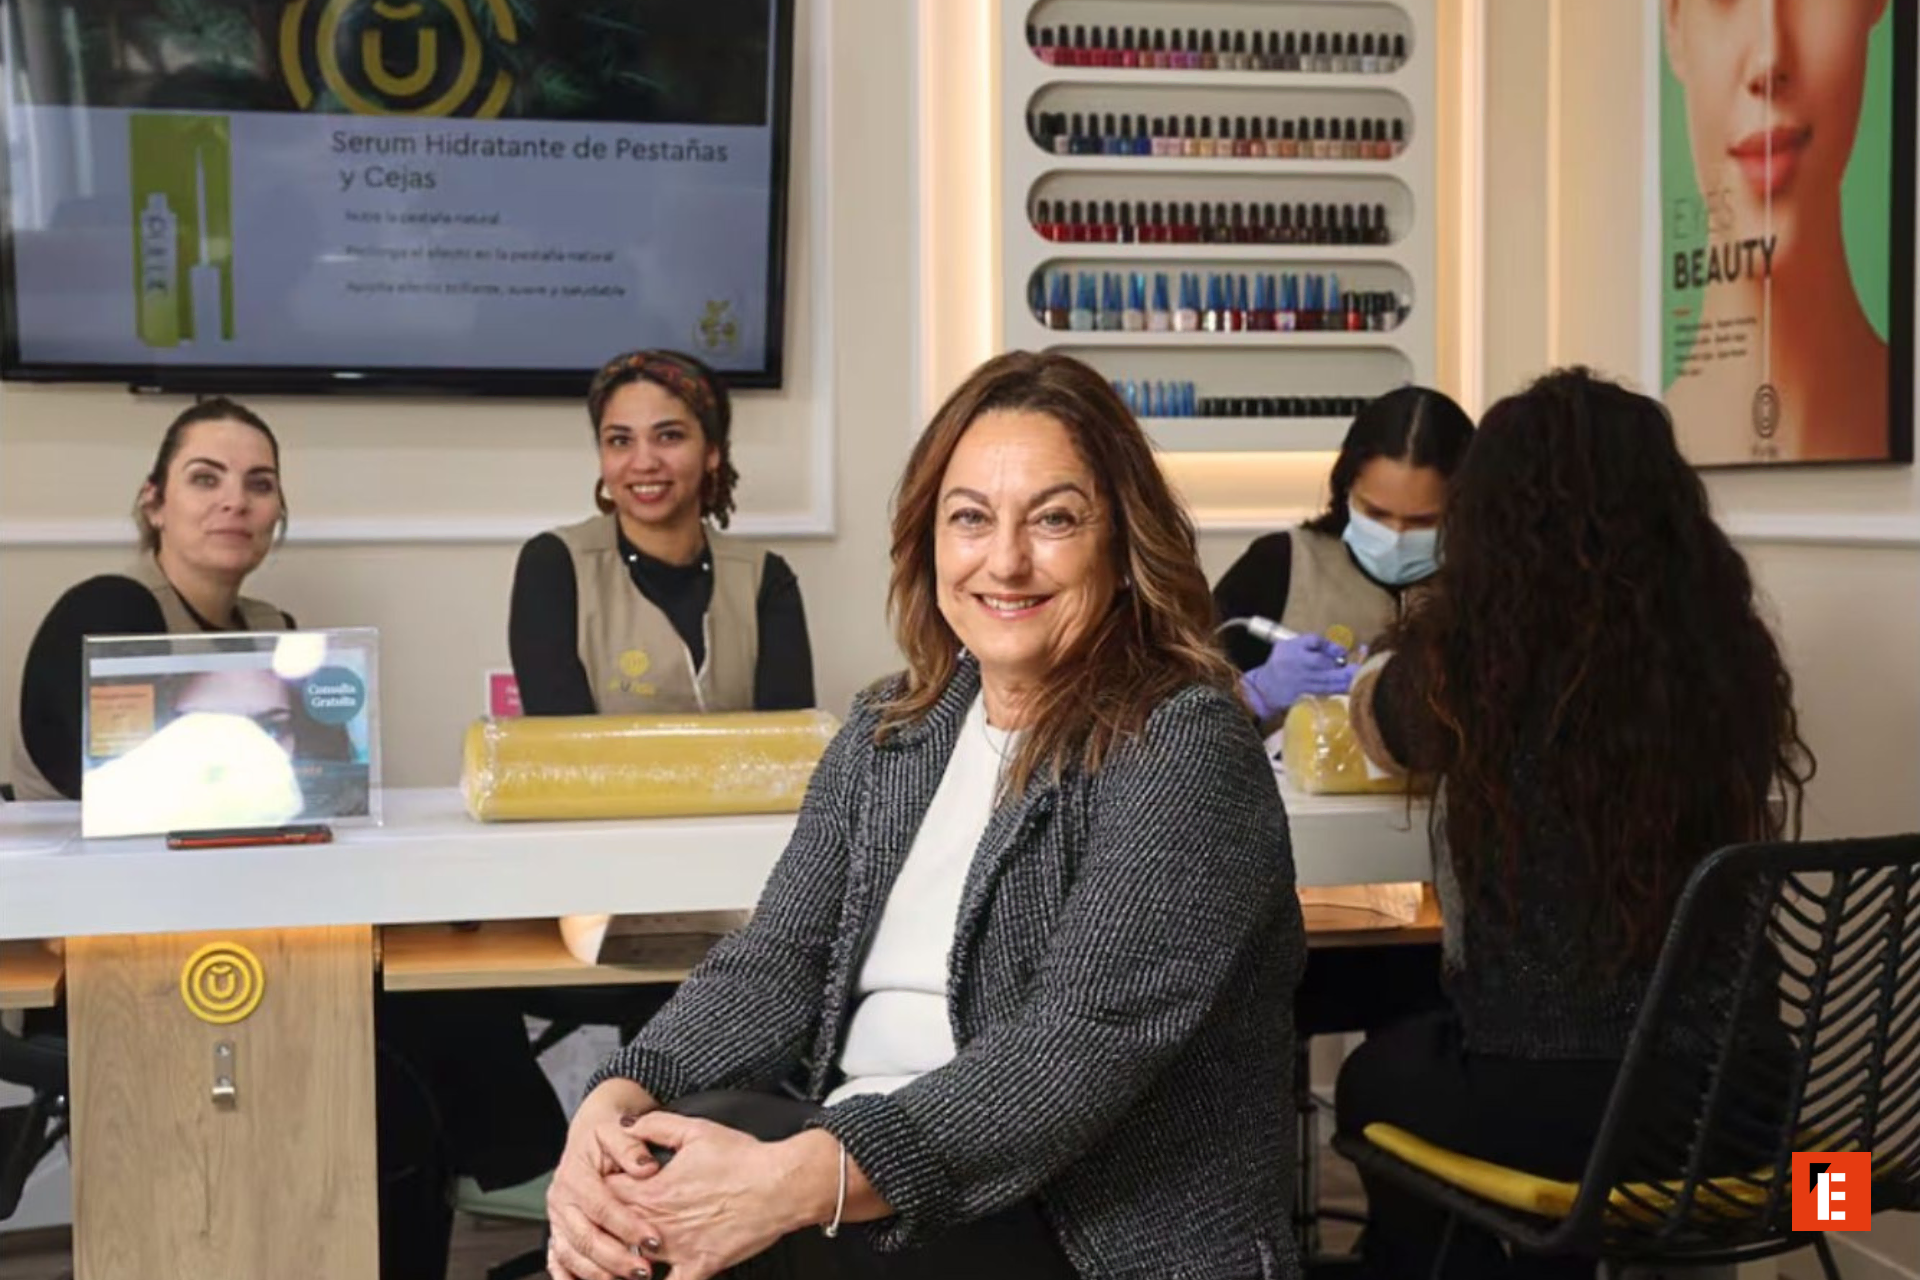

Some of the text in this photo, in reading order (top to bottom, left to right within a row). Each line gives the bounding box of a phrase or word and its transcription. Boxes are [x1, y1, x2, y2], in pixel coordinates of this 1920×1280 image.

[332, 130, 728, 162] Serum Hidratante de Pestañas
[339, 165, 436, 193] y Cejas
[1672, 234, 1777, 291] BEAUTY
